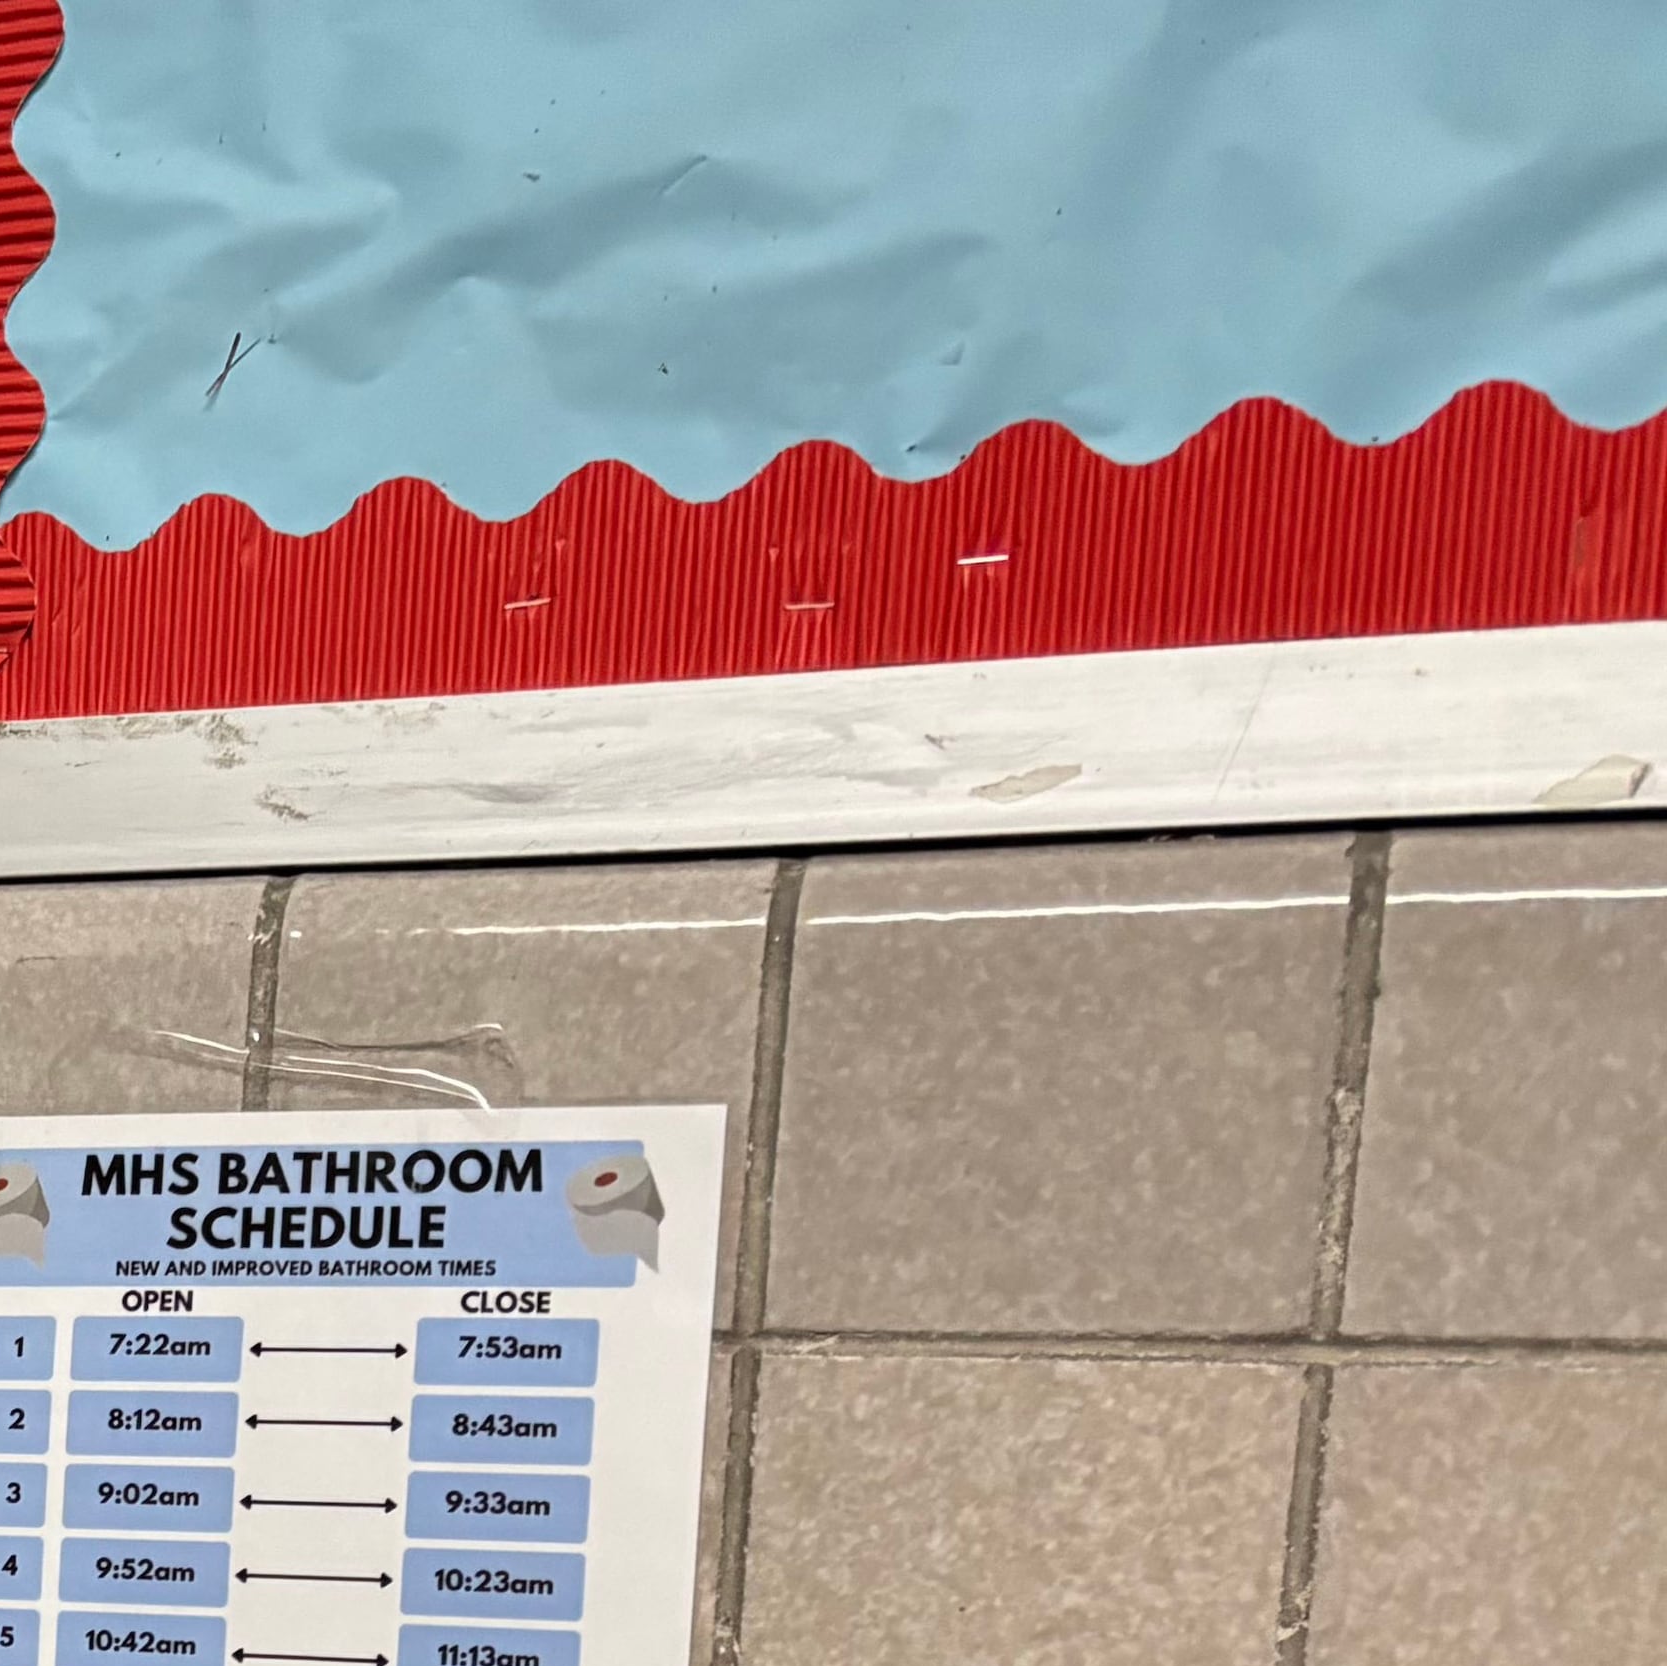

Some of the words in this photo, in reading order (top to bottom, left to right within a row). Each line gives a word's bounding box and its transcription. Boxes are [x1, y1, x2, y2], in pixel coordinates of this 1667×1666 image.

[81, 1152, 199, 1196] MHS
[217, 1148, 543, 1195] BATHROOM
[166, 1205, 447, 1250] SCHEDULE
[115, 1260, 161, 1277] NEW
[164, 1260, 207, 1276] AND
[211, 1260, 313, 1277] IMPROVED
[318, 1259, 432, 1277] BATHROOM
[437, 1259, 496, 1277] TIMES
[121, 1290, 193, 1312] OPEN
[460, 1290, 551, 1314] CLOSE
[14, 1336, 24, 1358] 1
[109, 1332, 211, 1356] 7:22am
[458, 1335, 562, 1360] 7:53am
[8, 1407, 25, 1430] 2
[107, 1408, 202, 1431] 8:12am
[452, 1413, 558, 1438] 8:43am
[5, 1481, 21, 1504] 3
[97, 1481, 199, 1507] 9:02am
[445, 1490, 551, 1516] 9:33am
[1, 1554, 19, 1576] 4
[95, 1556, 195, 1582] 9:52am
[434, 1568, 554, 1595] 10:23am
[0, 1625, 15, 1648] 5
[85, 1629, 196, 1656] 10:42am
